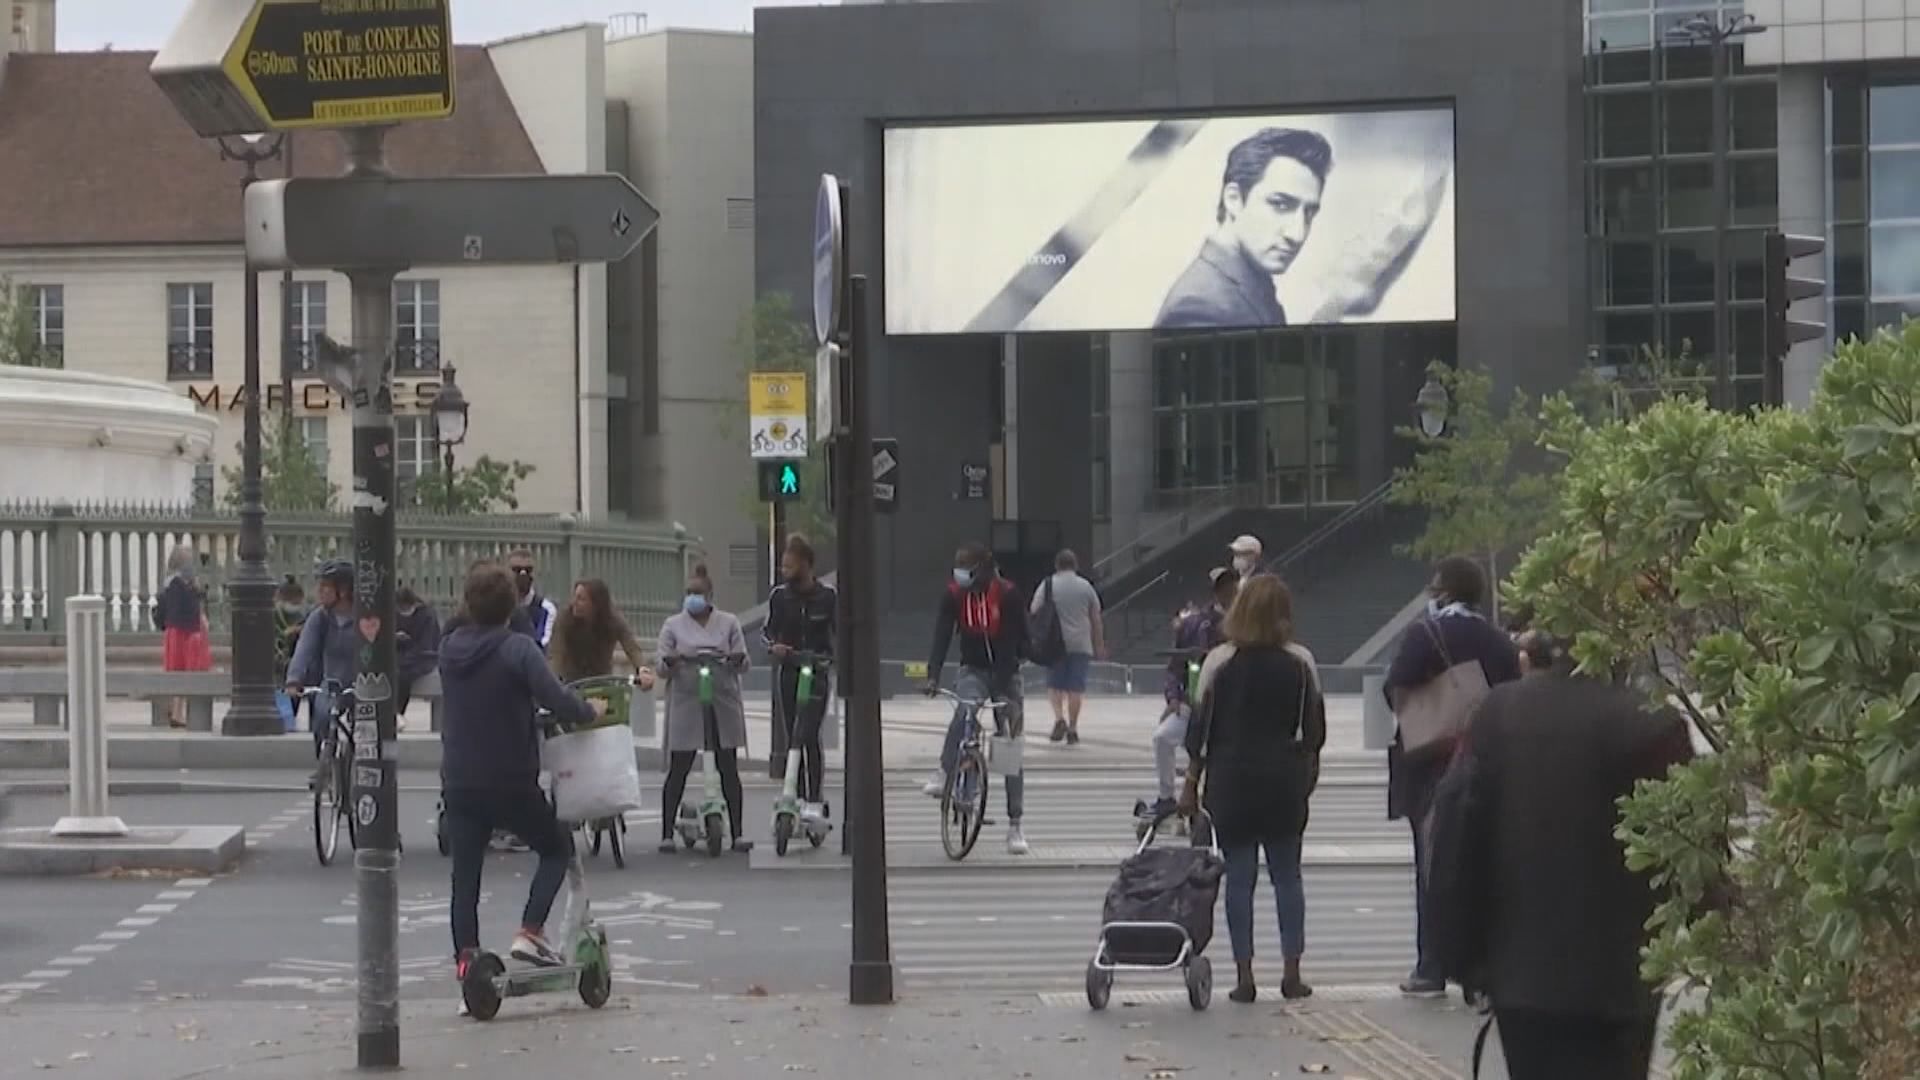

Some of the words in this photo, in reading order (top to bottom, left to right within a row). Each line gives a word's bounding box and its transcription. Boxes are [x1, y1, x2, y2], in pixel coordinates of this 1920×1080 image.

[303, 30, 344, 55] PORT
[346, 35, 363, 51] DE
[365, 25, 441, 50] CONFLANS
[307, 52, 442, 82] SAINTE-HONORINE
